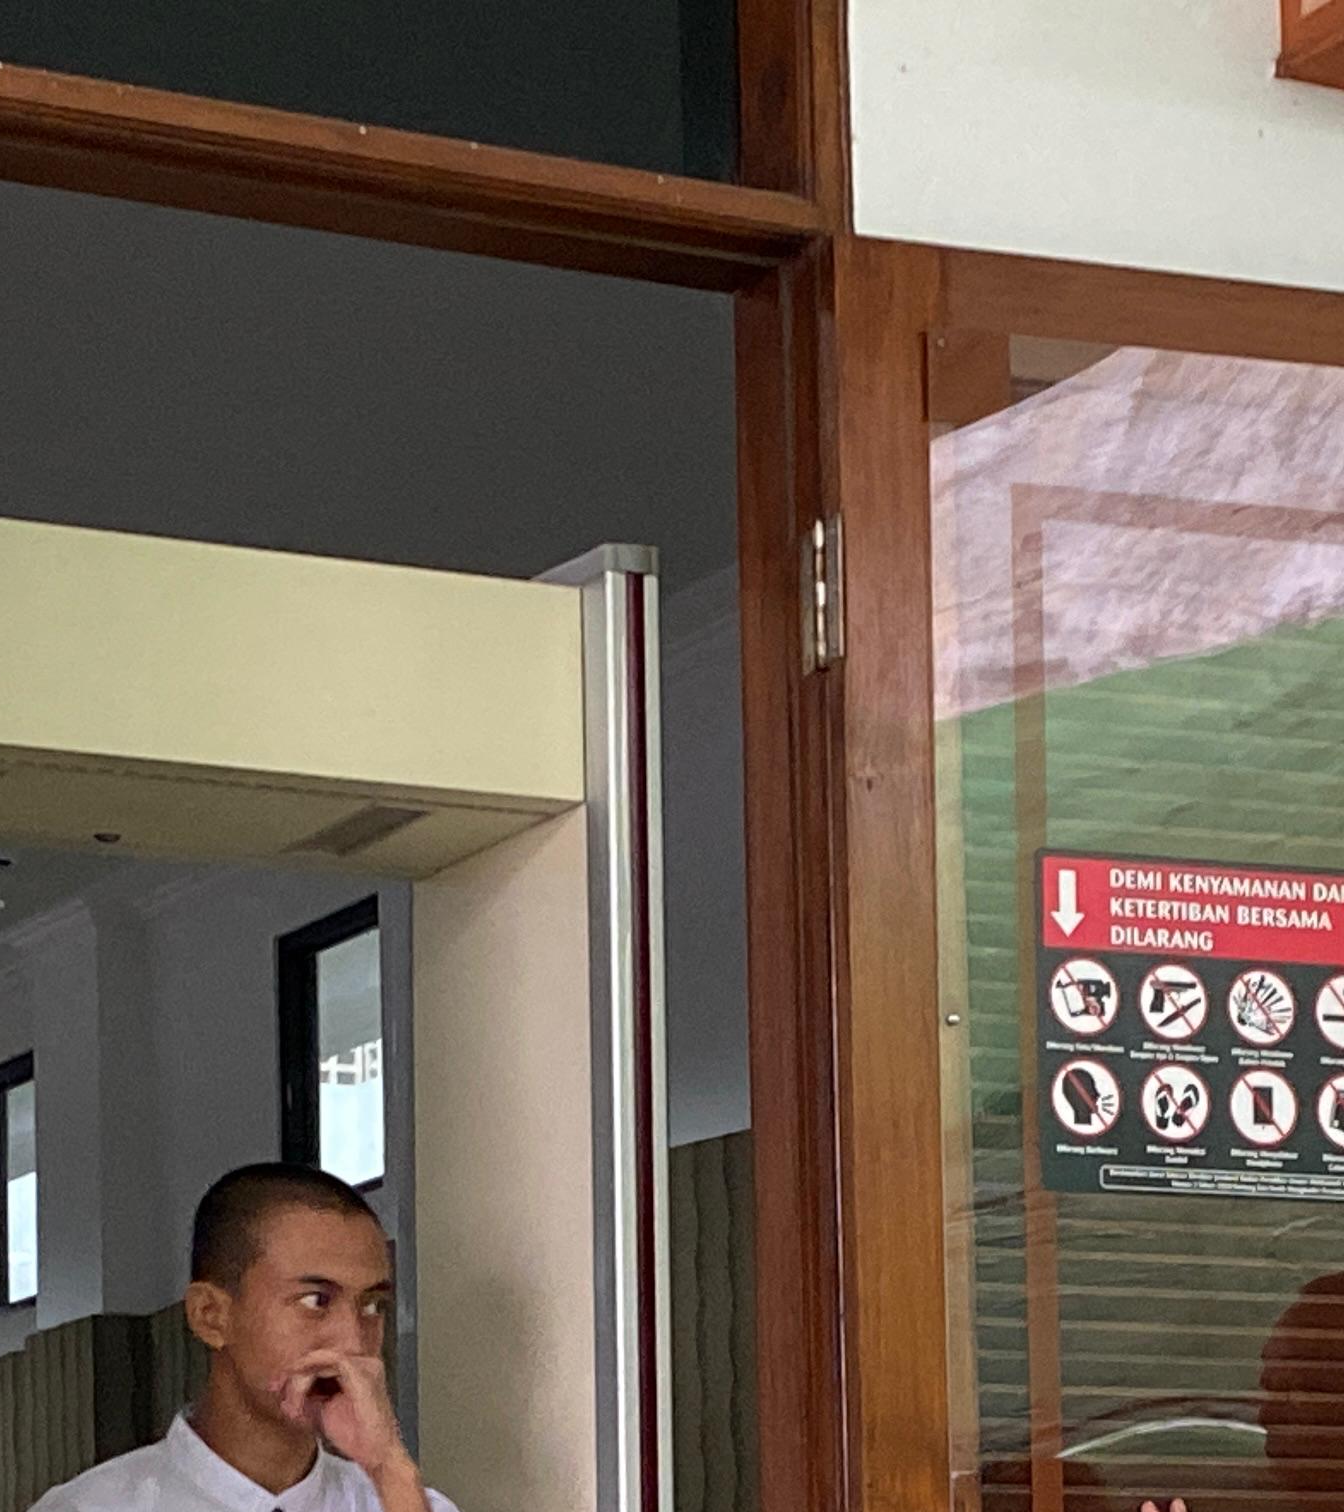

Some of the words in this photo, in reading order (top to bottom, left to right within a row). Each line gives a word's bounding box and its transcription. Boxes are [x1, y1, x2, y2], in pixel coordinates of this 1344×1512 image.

[1109, 868, 1162, 890] DEMI
[1169, 872, 1305, 900] KENYAMANAN
[1109, 896, 1229, 924] KETERTIBAN
[1236, 905, 1333, 931] BERSAMA
[1110, 925, 1214, 951] DILARANG
